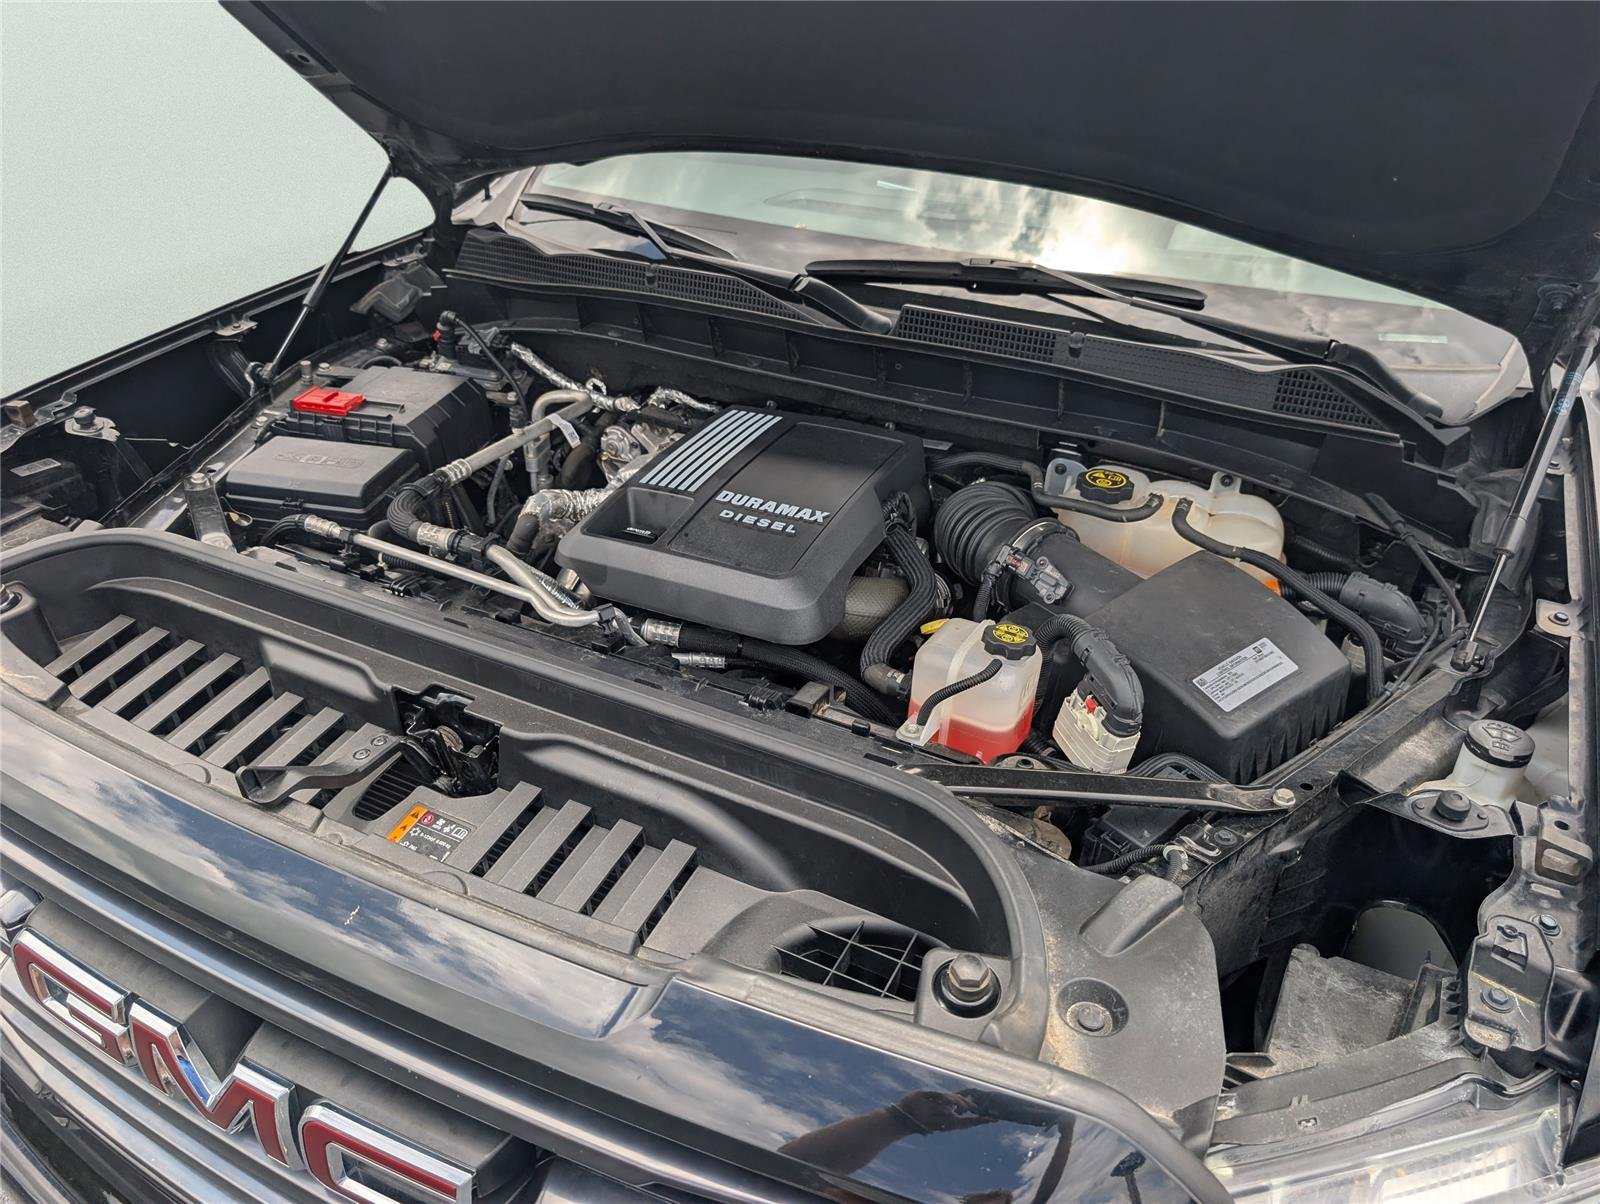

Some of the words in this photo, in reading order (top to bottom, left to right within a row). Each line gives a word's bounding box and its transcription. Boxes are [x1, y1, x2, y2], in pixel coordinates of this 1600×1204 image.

[715, 490, 831, 523] DURAMAX
[719, 509, 797, 534] DIESEL
[12, 926, 476, 1204] GMC
